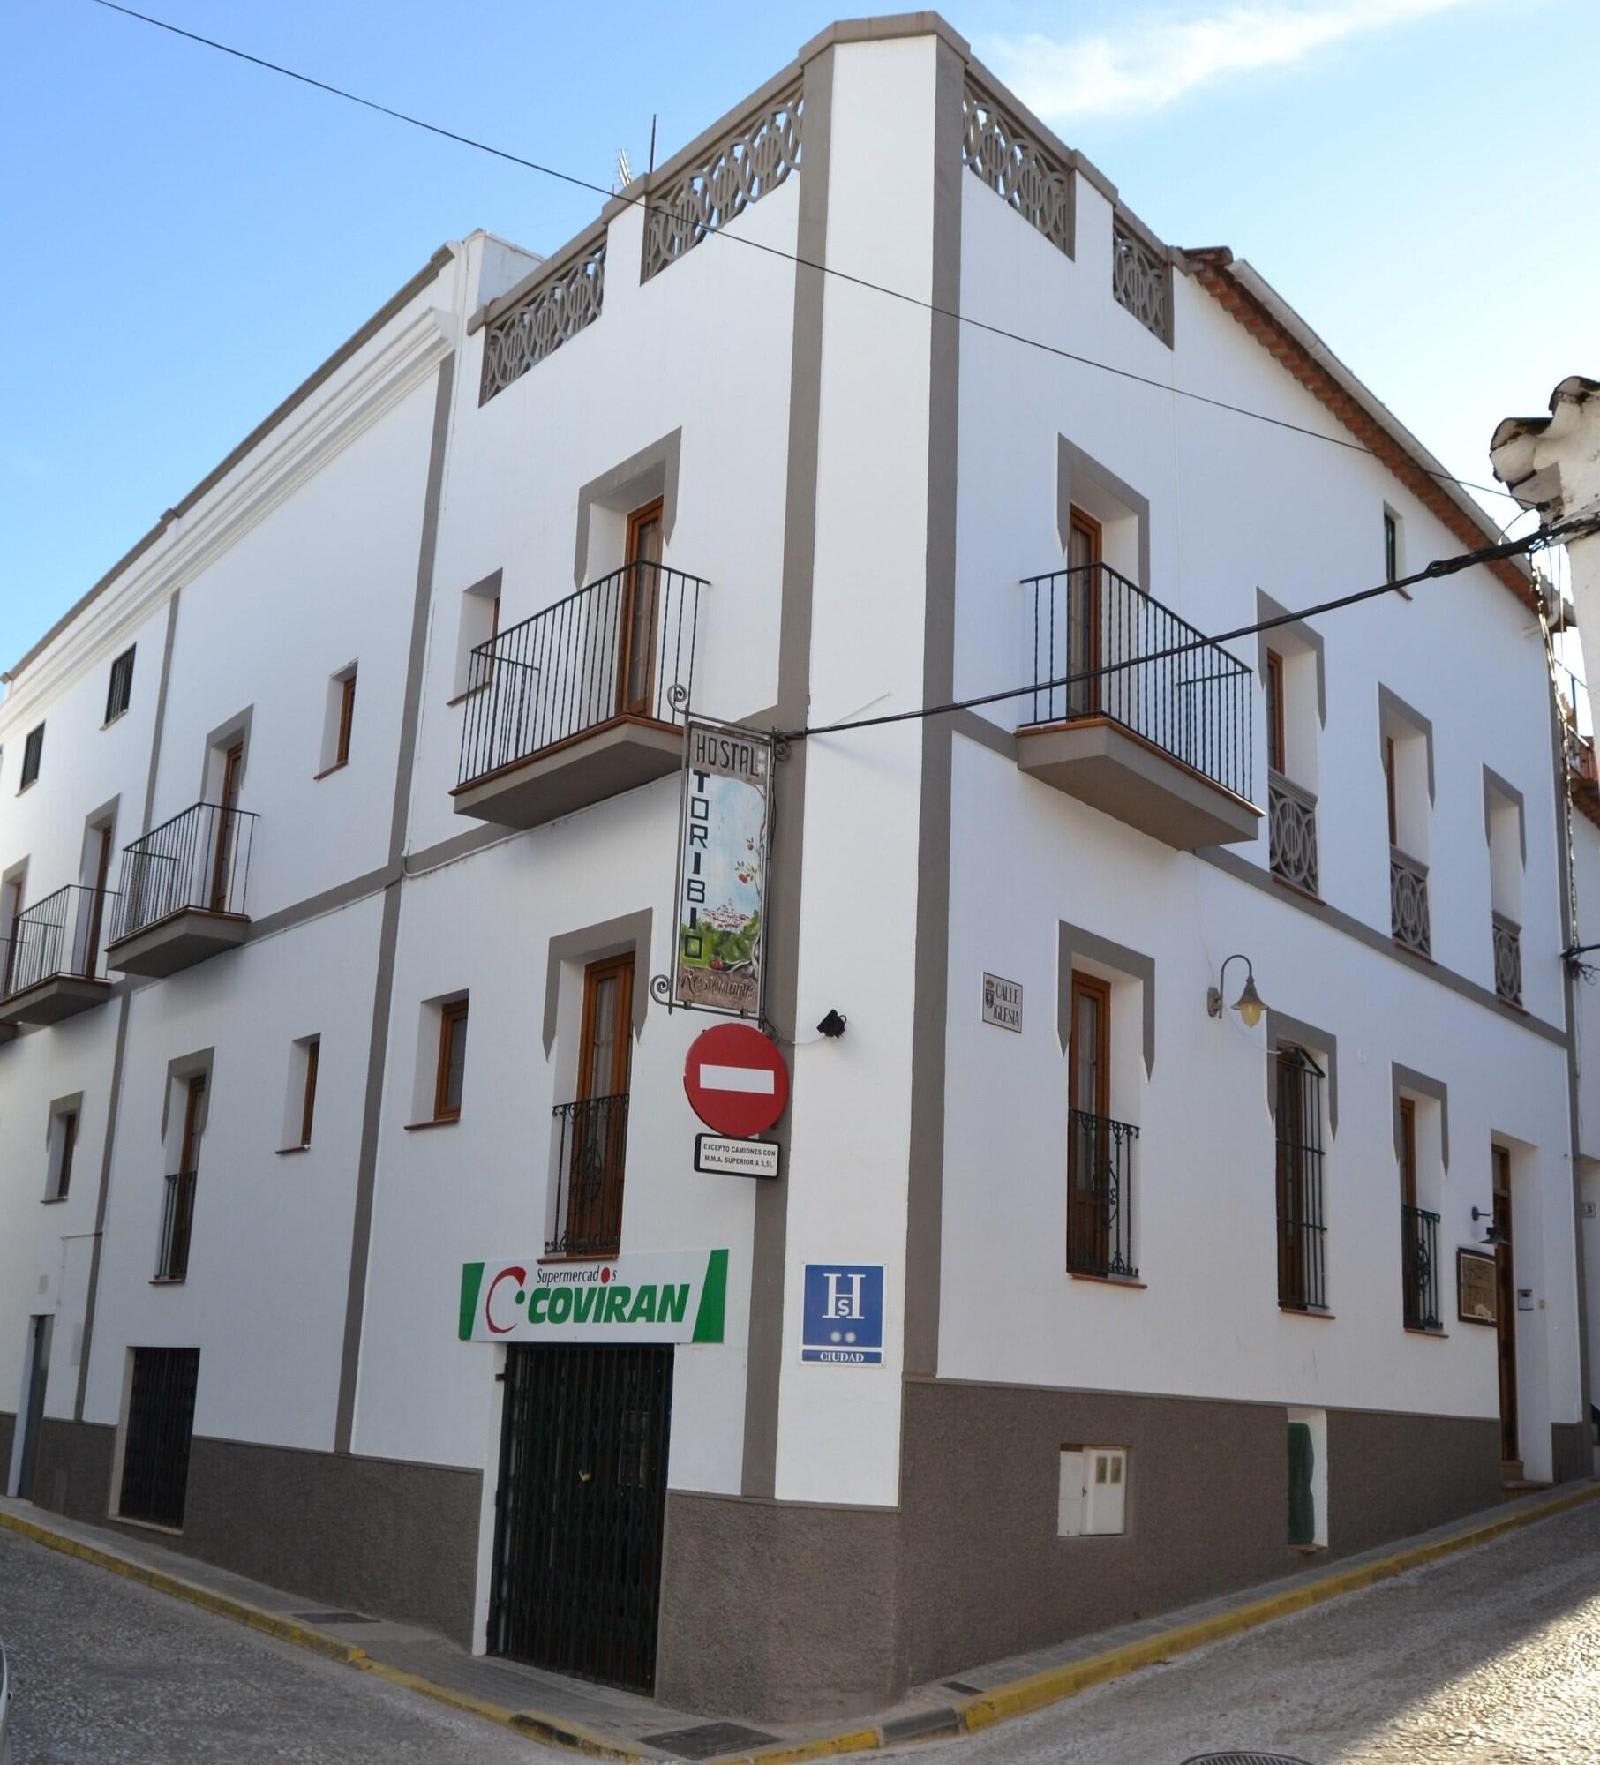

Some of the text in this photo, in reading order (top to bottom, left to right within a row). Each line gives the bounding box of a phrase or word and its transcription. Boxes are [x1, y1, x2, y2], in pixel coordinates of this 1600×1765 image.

[696, 734, 759, 777] HOSTAL
[685, 769, 710, 959] TORIBIO
[995, 982, 1020, 1004] CALLE
[703, 1143, 776, 1157] EXCEPTO CAMIONES CON
[725, 1157, 754, 1166] SUPERIOR
[755, 1159, 760, 1167] A
[537, 1265, 617, 1287] Supermercados
[528, 1284, 690, 1324] COVIRAN
[820, 1351, 865, 1363] CIUDAD
